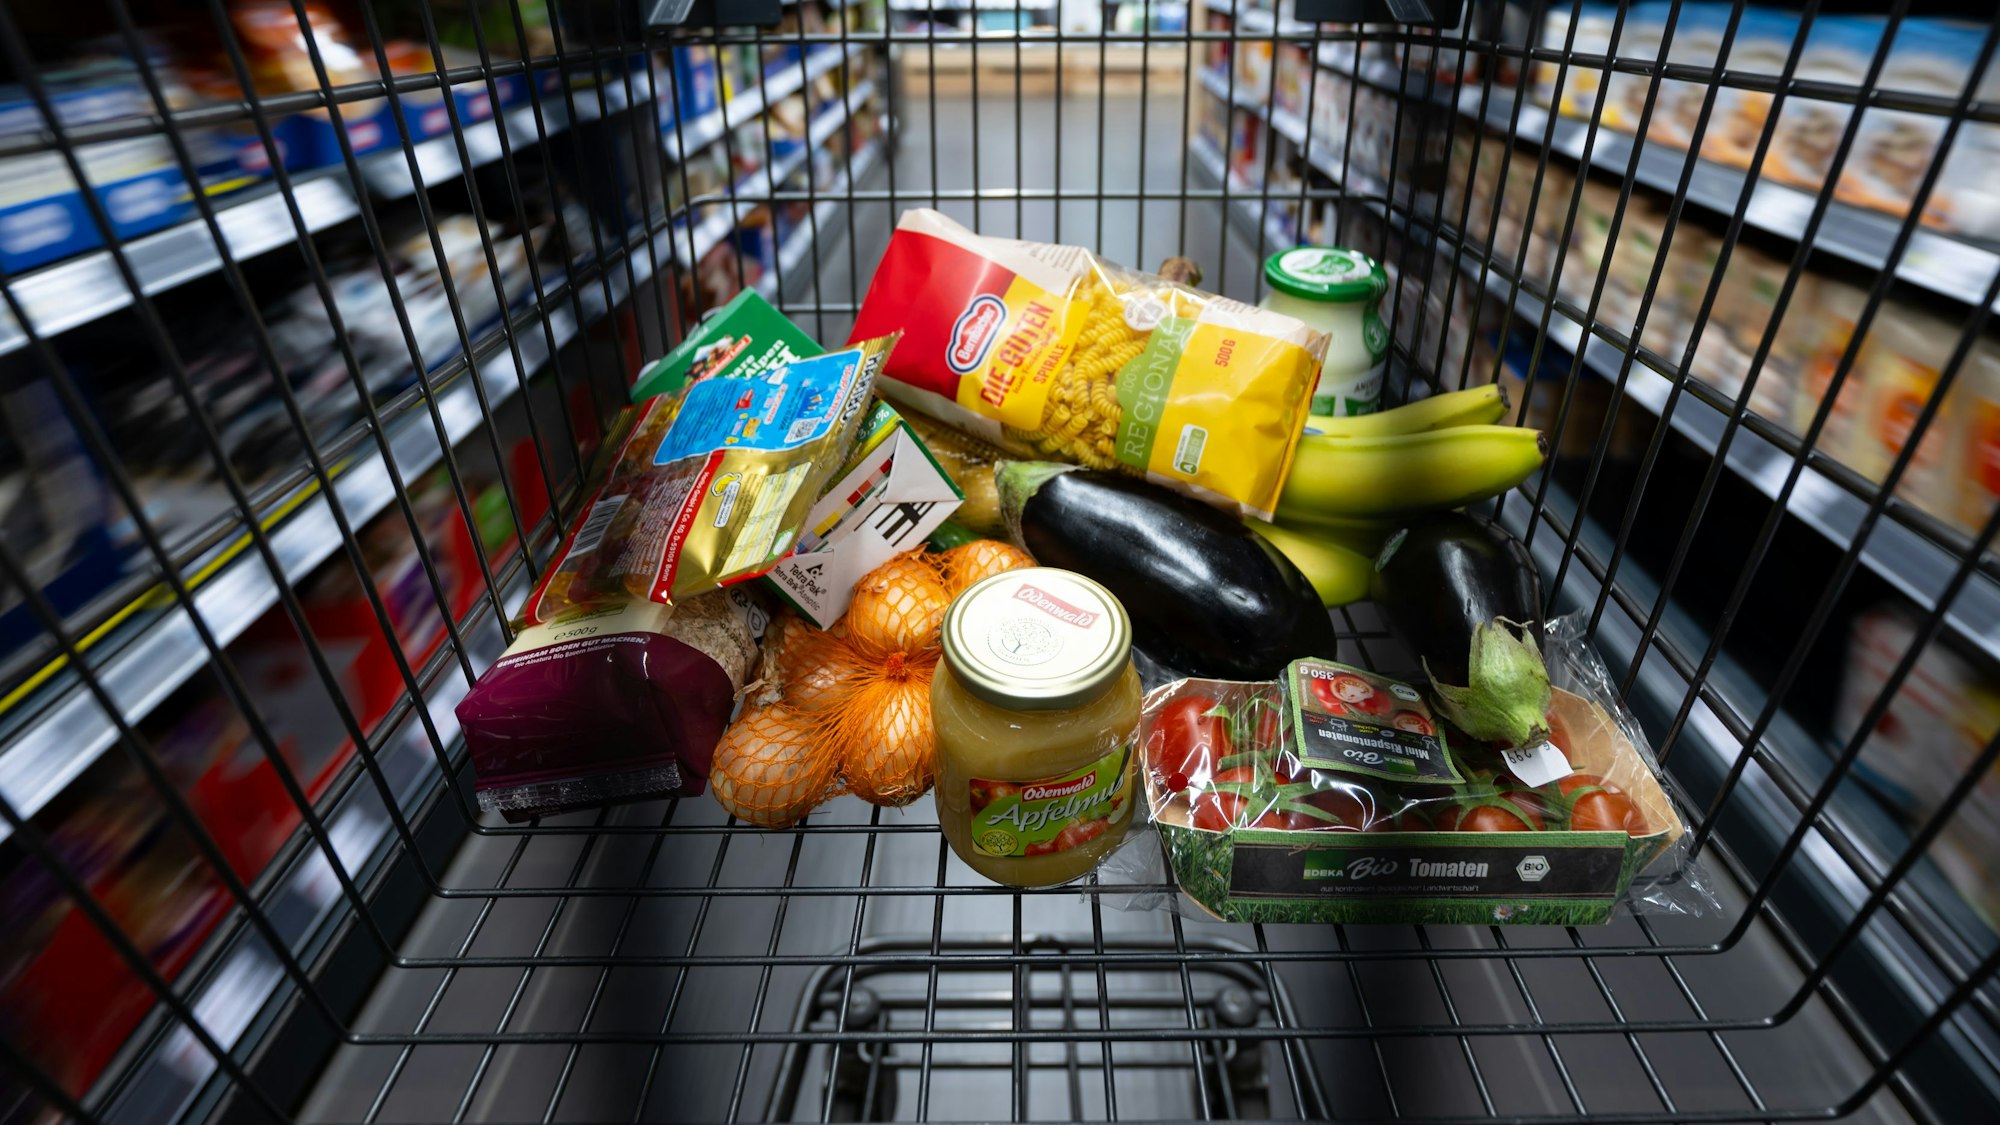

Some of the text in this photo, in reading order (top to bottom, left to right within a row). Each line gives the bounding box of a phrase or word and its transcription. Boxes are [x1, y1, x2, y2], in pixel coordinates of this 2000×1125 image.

[980, 366, 1015, 408] DIE
[999, 300, 1054, 368] GUTEN
[1213, 336, 1235, 367] 500 G
[1033, 343, 1068, 384] SPIRALE
[1124, 323, 1186, 458] REGIONAL
[687, 488, 700, 508] GmbH
[680, 512, 689, 524] Co.
[664, 534, 681, 563] D-53105
[660, 562, 672, 582] Bonn
[788, 563, 809, 584] Tetra
[772, 565, 789, 581] Tetra
[796, 588, 821, 612] Aseptic
[1018, 588, 1093, 626] Odenwald
[497, 636, 646, 668] GEMEINSAM BODEN GUT MACHEN.
[525, 655, 551, 666] Alnatura
[565, 649, 586, 658] Bauern
[587, 643, 615, 652] Initiative
[1300, 666, 1308, 675] g
[1311, 670, 1334, 681] 350
[1318, 729, 1405, 755] Rispentomaten
[1405, 746, 1430, 760] Mini
[1343, 749, 1384, 765] Bio
[1023, 775, 1095, 800] Odenwald
[985, 773, 1125, 832] Apfelmus
[1304, 857, 1489, 880] EDEKA Bio Tomaten
[1523, 863, 1544, 872] BIO
[1423, 884, 1479, 892] Landwirtschaft
